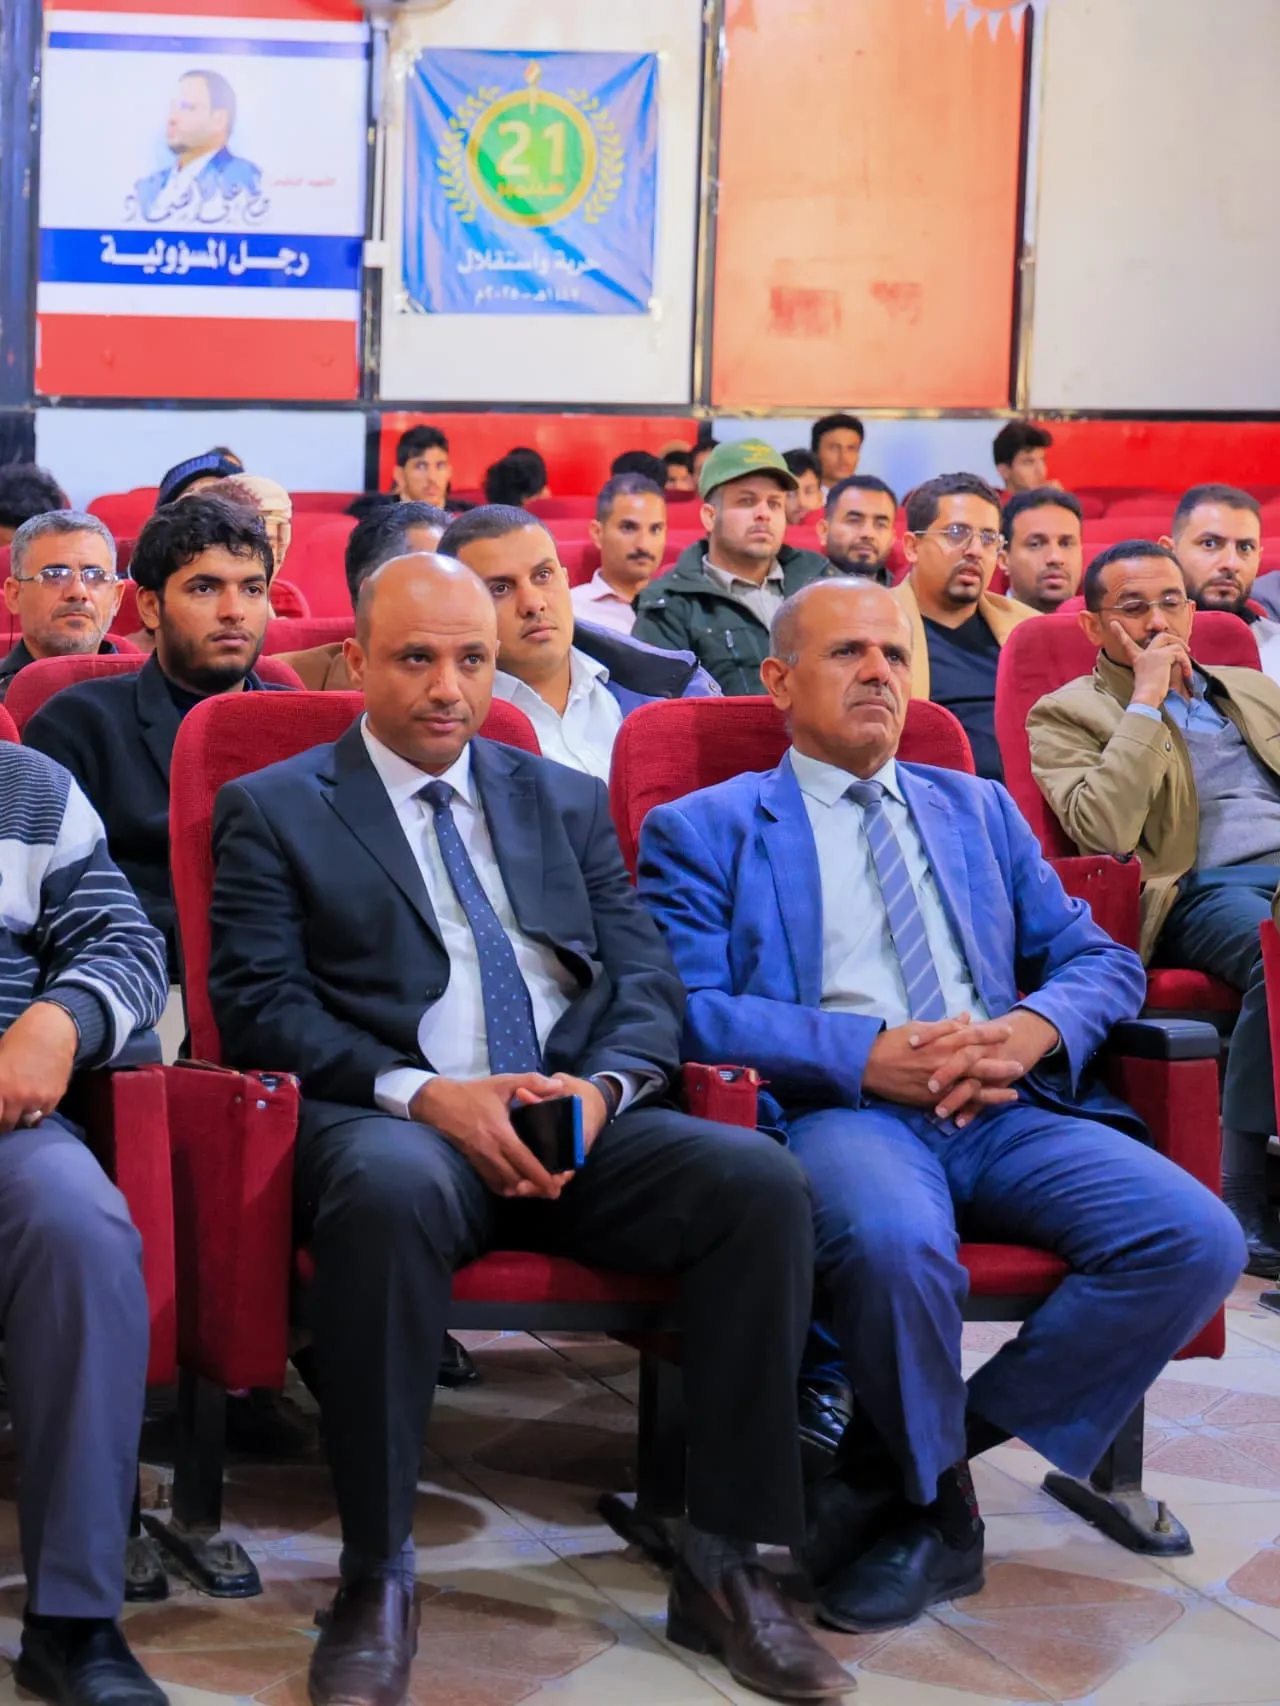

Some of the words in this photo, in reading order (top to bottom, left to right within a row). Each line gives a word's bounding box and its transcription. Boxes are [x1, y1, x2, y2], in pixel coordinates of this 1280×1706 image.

[496, 120, 565, 176] 21
[99, 234, 228, 276] المسؤولية
[228, 240, 311, 277] رجل
[457, 247, 550, 276] واستقلال
[555, 249, 601, 276] حرية
